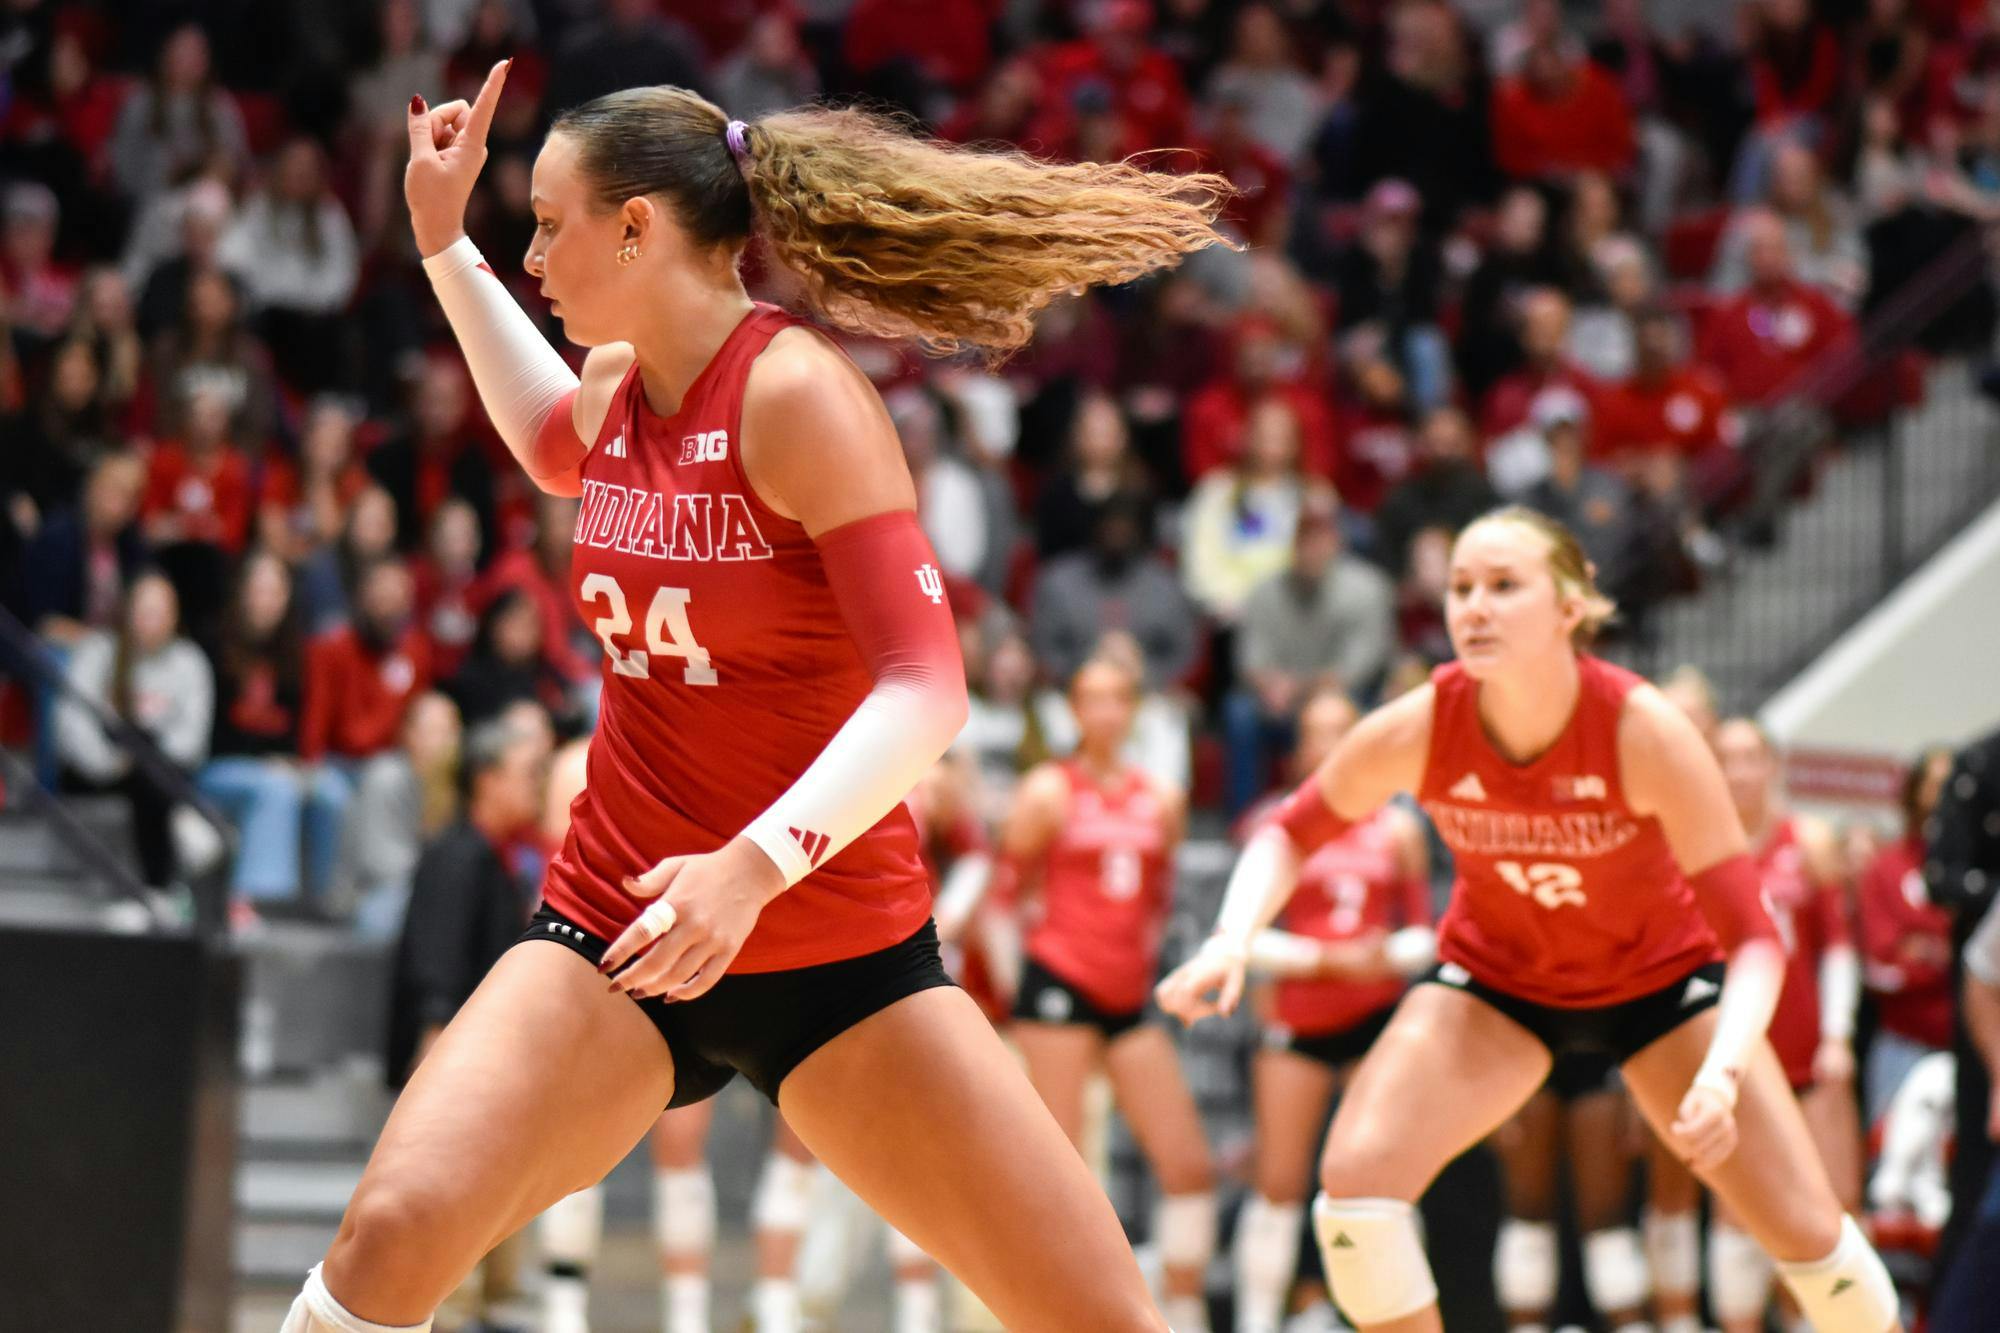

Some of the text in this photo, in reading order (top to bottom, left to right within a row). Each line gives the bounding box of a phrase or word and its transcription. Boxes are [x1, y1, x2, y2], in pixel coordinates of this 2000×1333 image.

[678, 429, 728, 466] BIG
[580, 572, 719, 686] 24
[1494, 859, 1588, 909] 12
